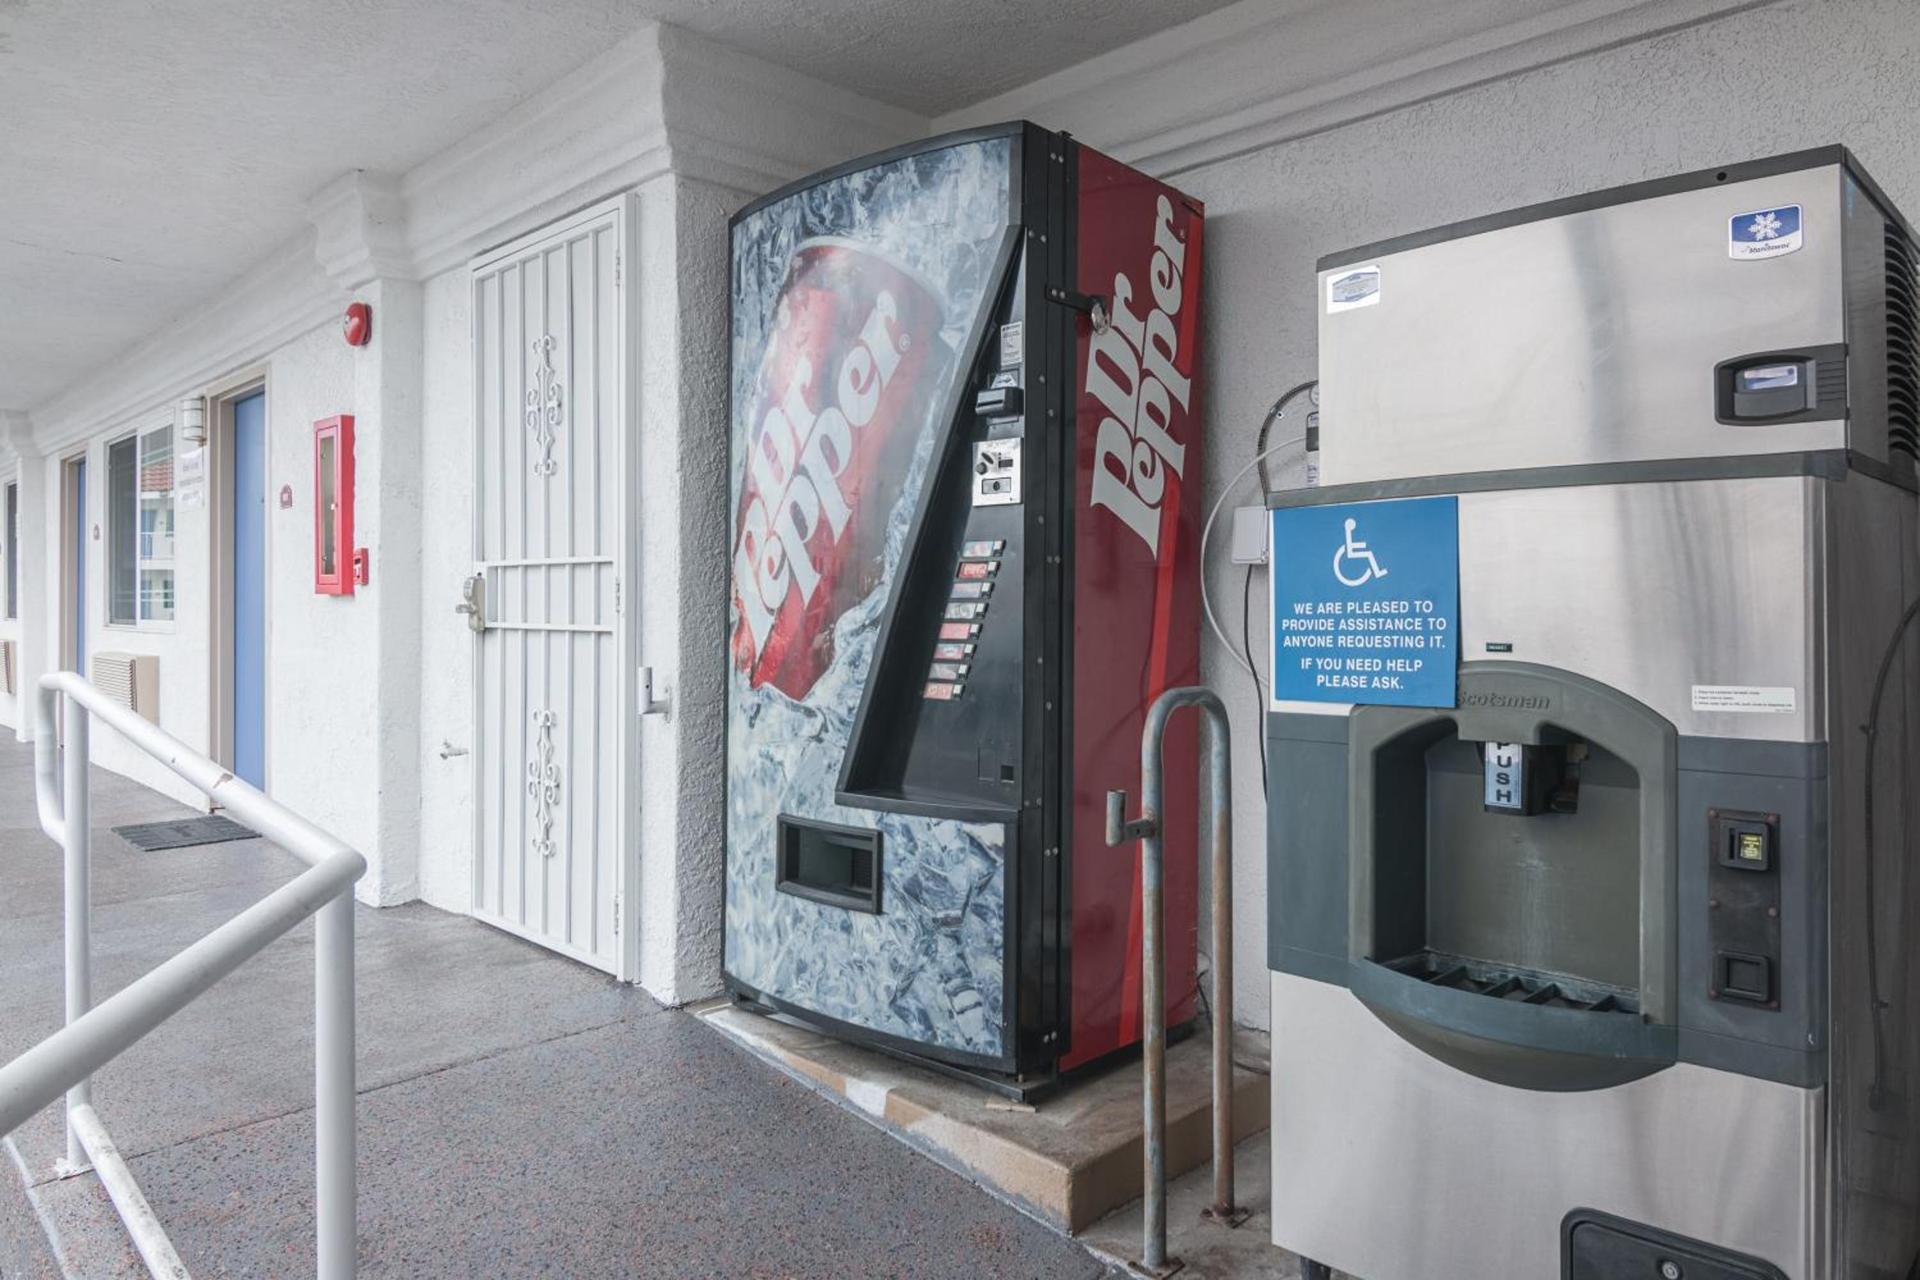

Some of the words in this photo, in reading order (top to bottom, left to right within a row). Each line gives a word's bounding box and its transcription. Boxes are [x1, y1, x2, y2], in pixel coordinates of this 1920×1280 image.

[1085, 272, 1146, 439] Dr
[1090, 194, 1191, 560] Pepper
[752, 355, 816, 525] Dr
[733, 290, 900, 657] Pepper
[1294, 602, 1313, 614] WE
[1317, 602, 1342, 614] ARE
[1347, 601, 1409, 614] PLEASED
[1414, 600, 1433, 613] TO
[1282, 619, 1334, 631] PROVIDE
[1338, 618, 1422, 631] ASSISTANCE
[1428, 618, 1447, 631] TO
[1283, 636, 1333, 648] ANYONE
[1338, 635, 1425, 649] REQUESTING
[1429, 636, 1445, 648] IT.
[1301, 658, 1312, 670] IF
[1316, 658, 1342, 671] YOU
[1346, 659, 1382, 671] NEED
[1386, 659, 1423, 672] HELP
[1316, 675, 1367, 688] PLEASE
[1372, 676, 1404, 689] ASK.
